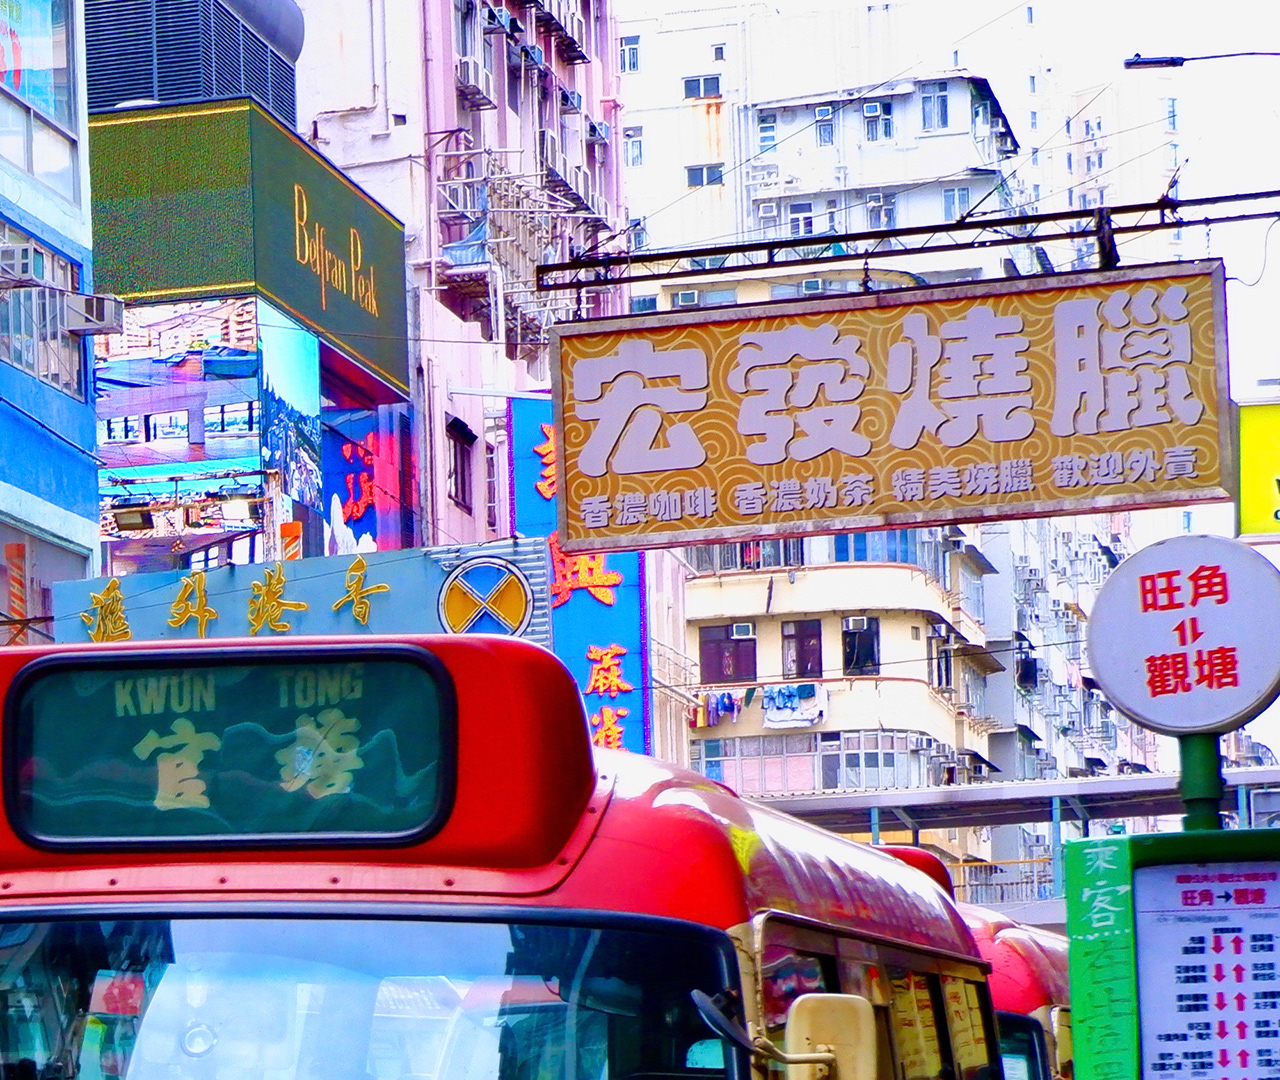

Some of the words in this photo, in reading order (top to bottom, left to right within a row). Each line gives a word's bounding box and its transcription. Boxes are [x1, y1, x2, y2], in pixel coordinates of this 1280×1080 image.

[293, 182, 347, 311] Belfran
[350, 226, 380, 319] Peak
[578, 484, 719, 531] 香濃咖啡
[734, 470, 876, 514] 香濃奶茶
[1051, 445, 1201, 488] 歡迎外賣
[1138, 564, 1230, 614] 旺角
[113, 673, 217, 718] KWUN
[278, 662, 366, 710] TONG
[1144, 645, 1240, 699] 觀塘
